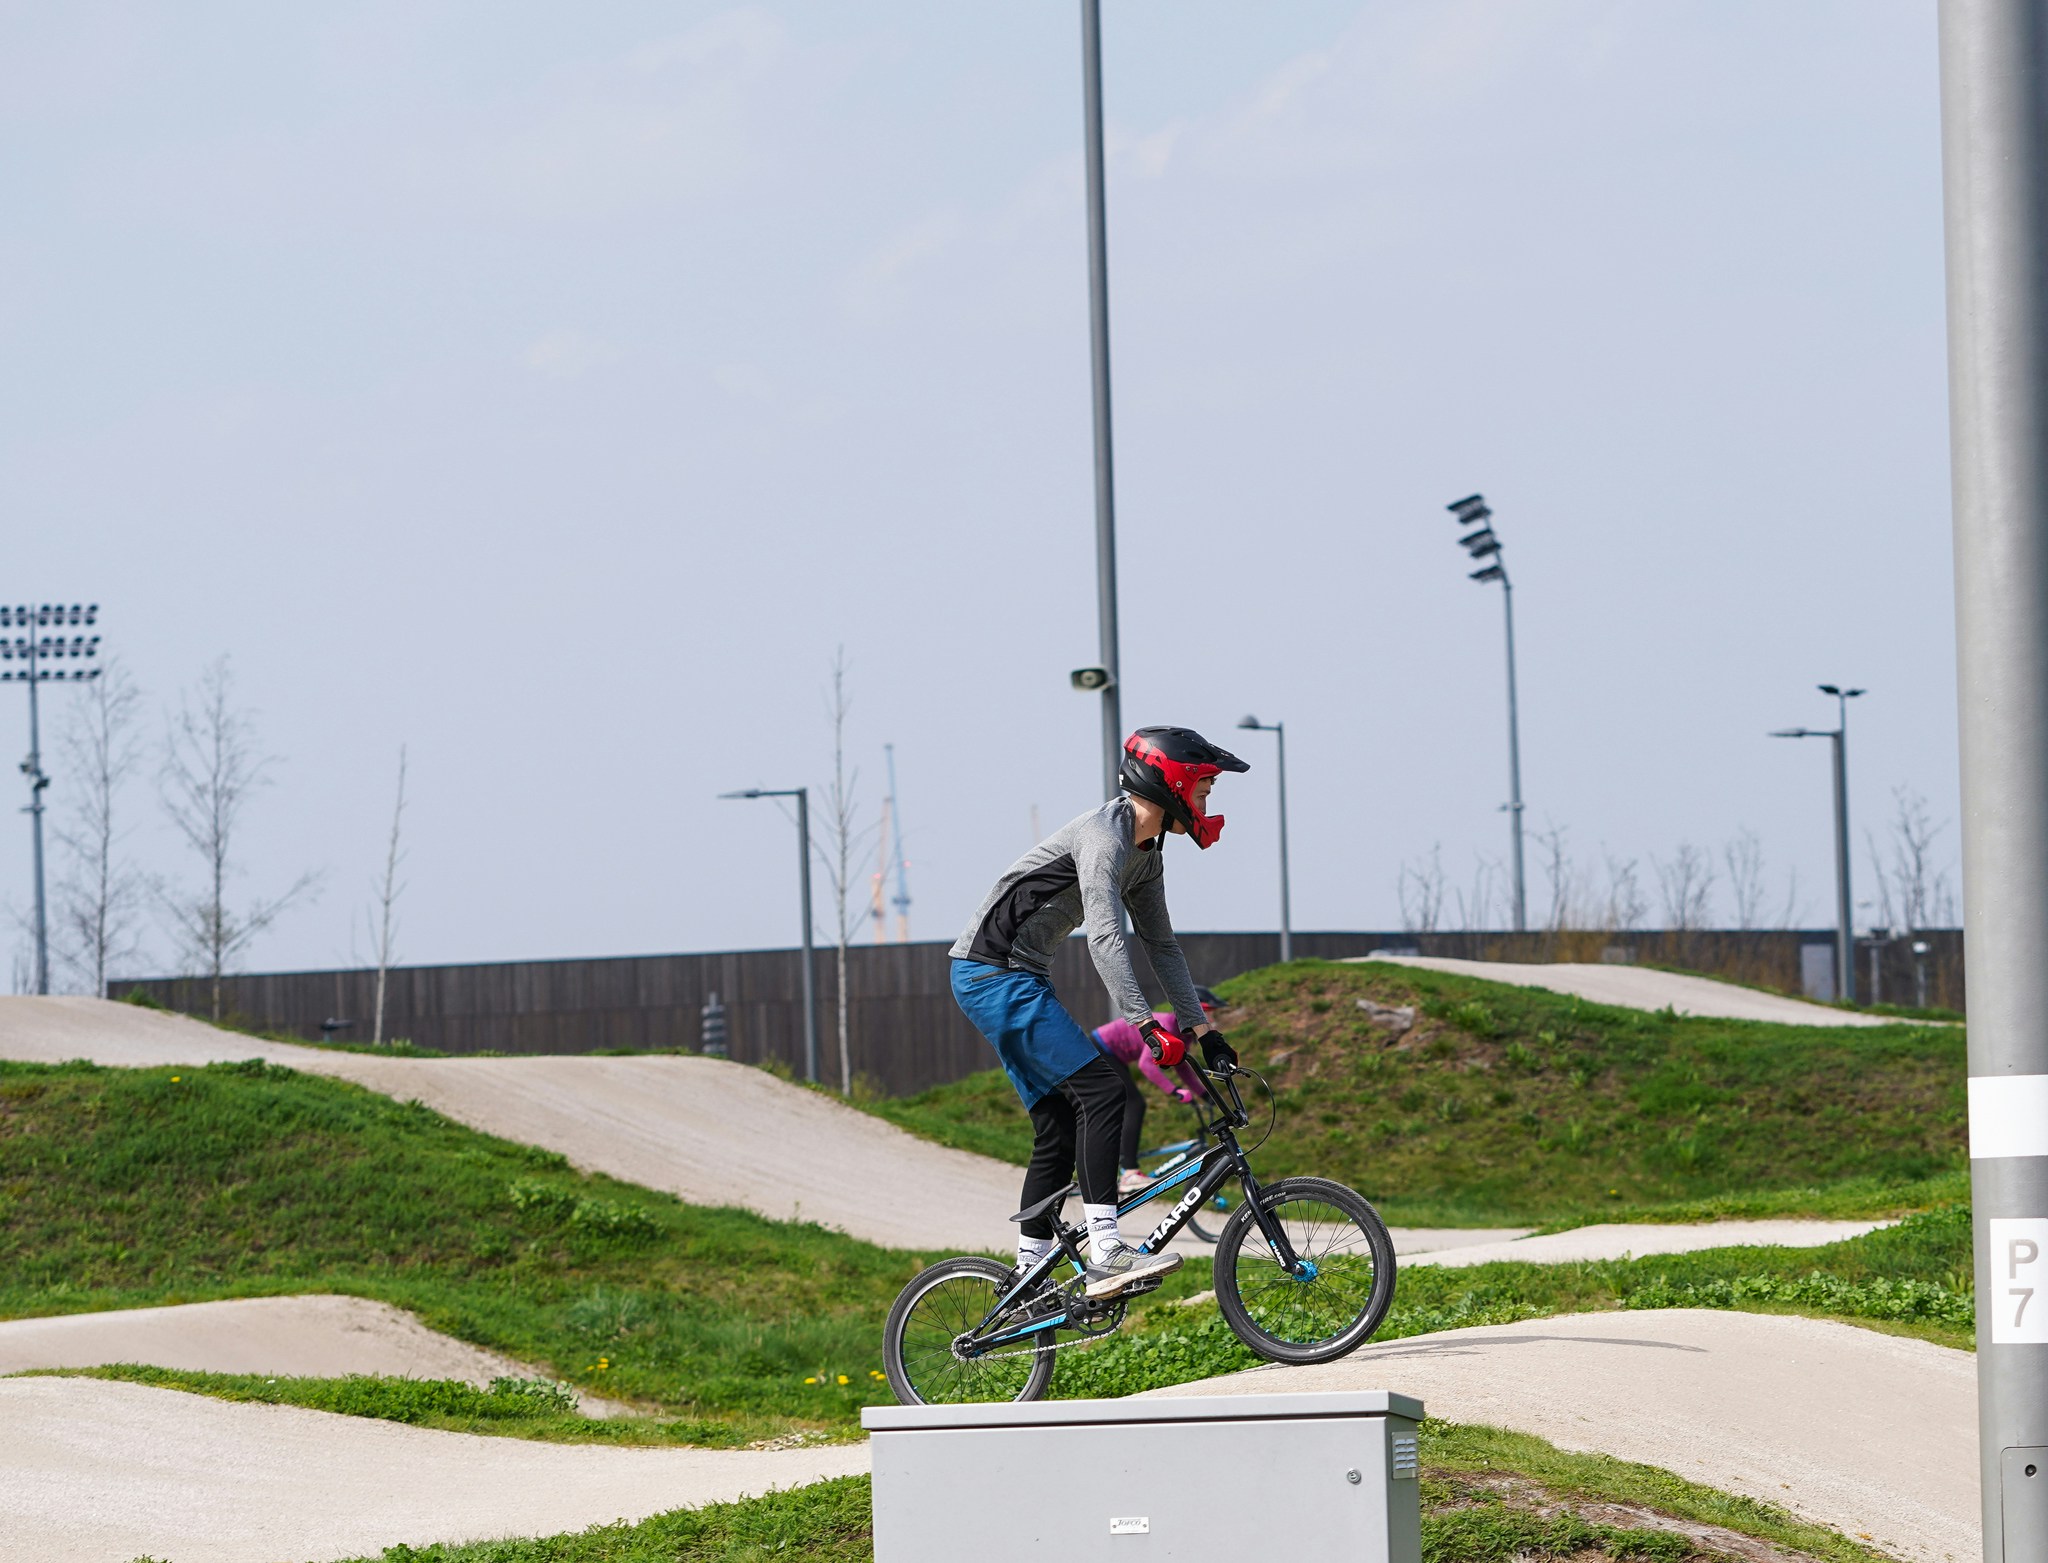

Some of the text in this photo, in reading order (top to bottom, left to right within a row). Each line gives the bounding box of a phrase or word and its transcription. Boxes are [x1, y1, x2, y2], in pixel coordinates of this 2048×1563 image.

[1147, 1187, 1201, 1249] HARO
[2009, 1239, 2039, 1279] P
[2009, 1288, 2034, 1327] 7
